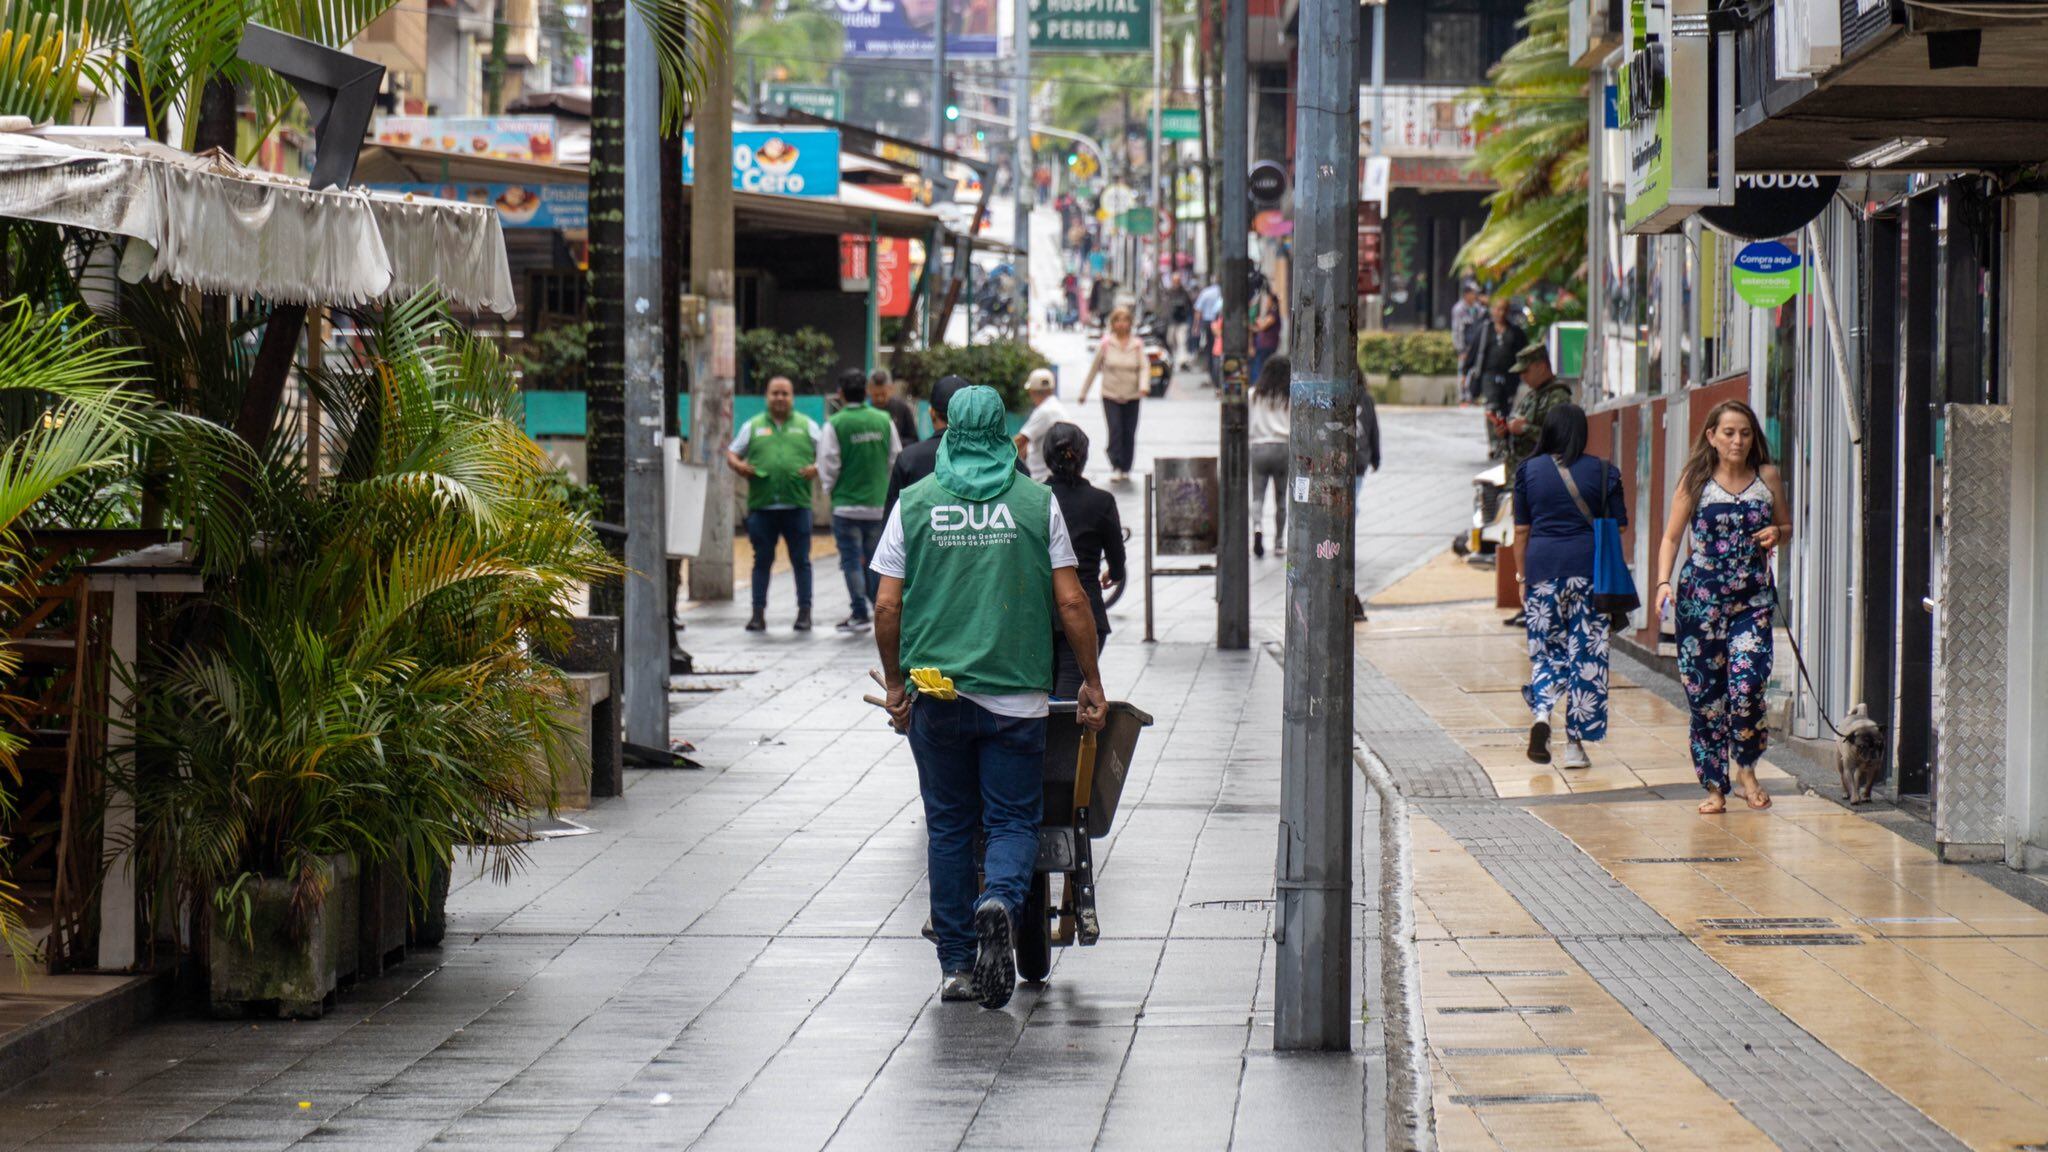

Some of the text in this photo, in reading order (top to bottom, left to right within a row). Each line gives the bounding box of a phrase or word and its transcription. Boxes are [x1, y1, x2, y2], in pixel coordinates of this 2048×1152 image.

[1047, 20, 1130, 40] PEREIRA
[741, 168, 805, 193] Cero
[1740, 254, 1773, 265] Compra
[930, 503, 1017, 532] EDUA
[931, 534, 965, 542] Empresa
[967, 533, 977, 541] de
[979, 537, 1011, 546] Armenia
